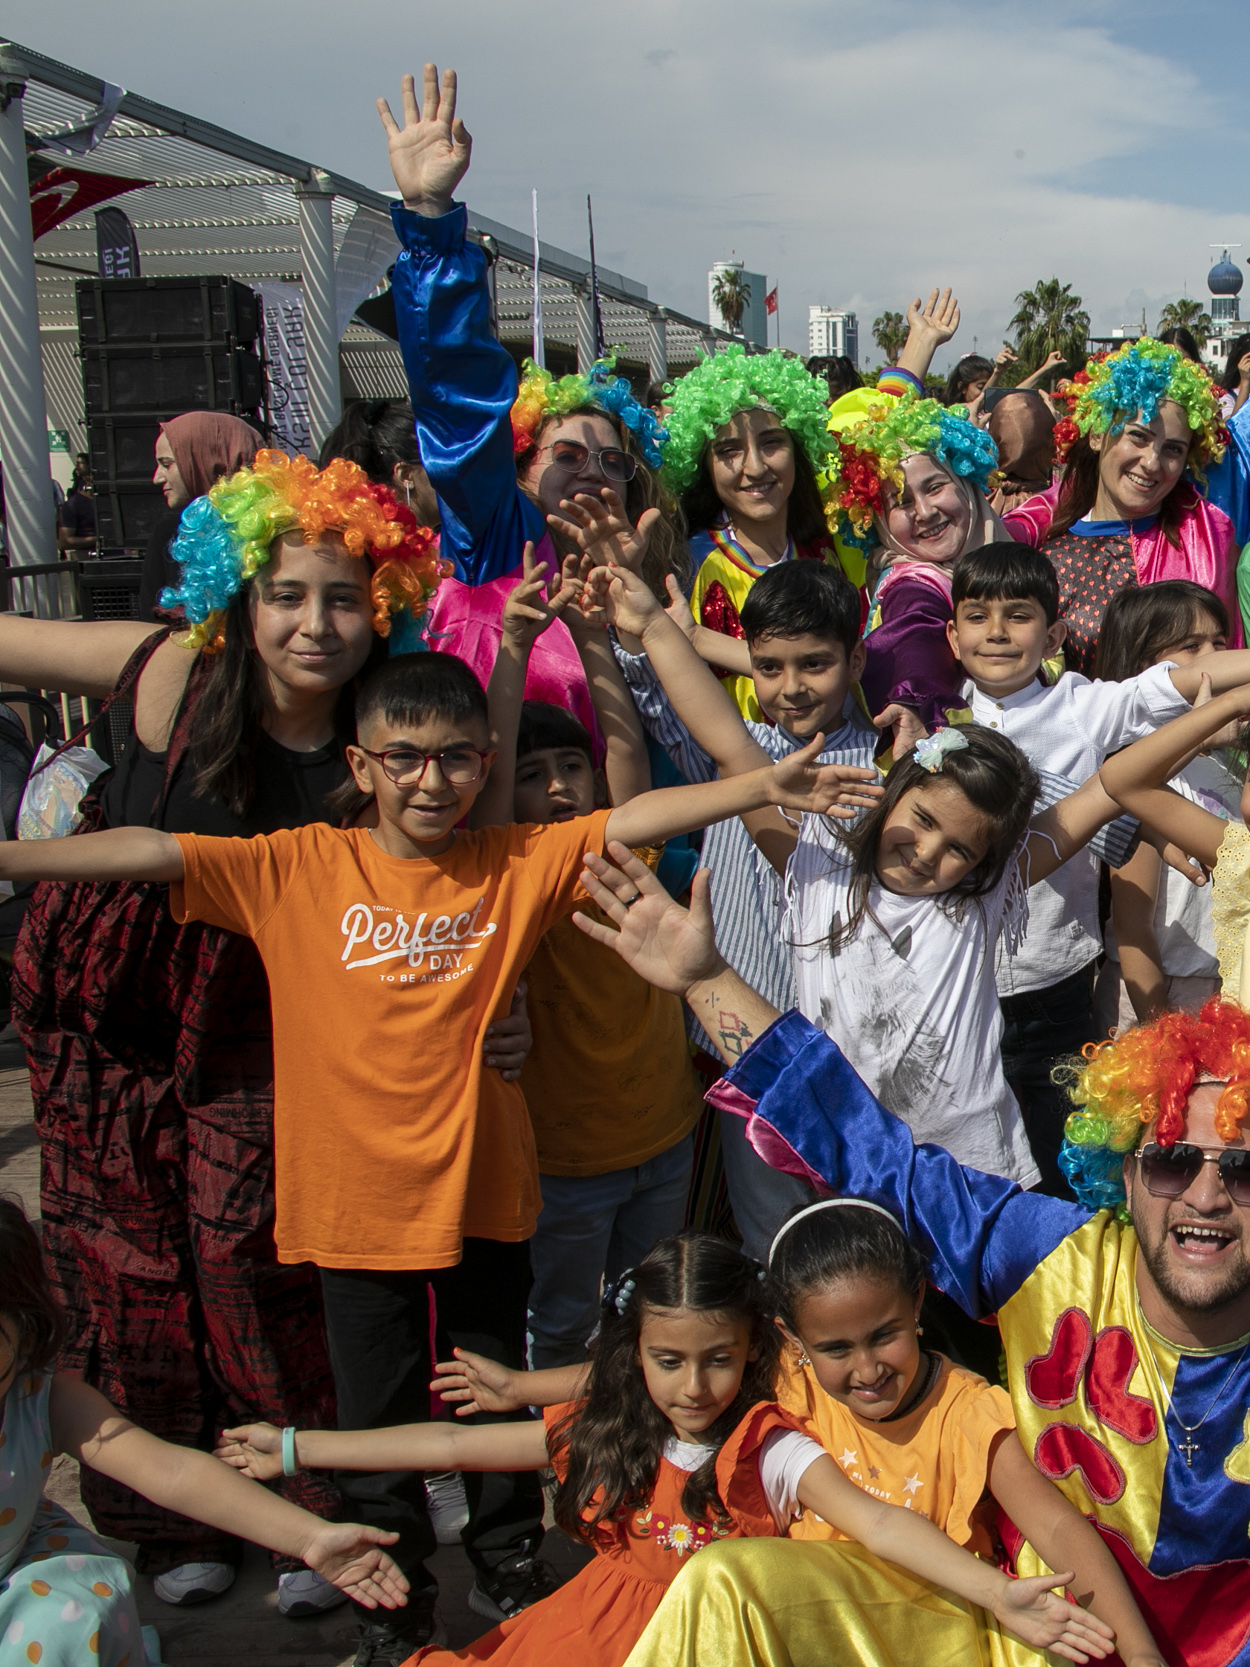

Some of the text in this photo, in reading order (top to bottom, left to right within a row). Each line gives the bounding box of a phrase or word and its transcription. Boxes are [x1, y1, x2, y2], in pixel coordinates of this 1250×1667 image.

[341, 897, 488, 967] Perfect
[429, 953, 464, 970] DAY
[379, 963, 474, 983] TO BE AWESOME
[865, 1485, 892, 1499] TODAY
